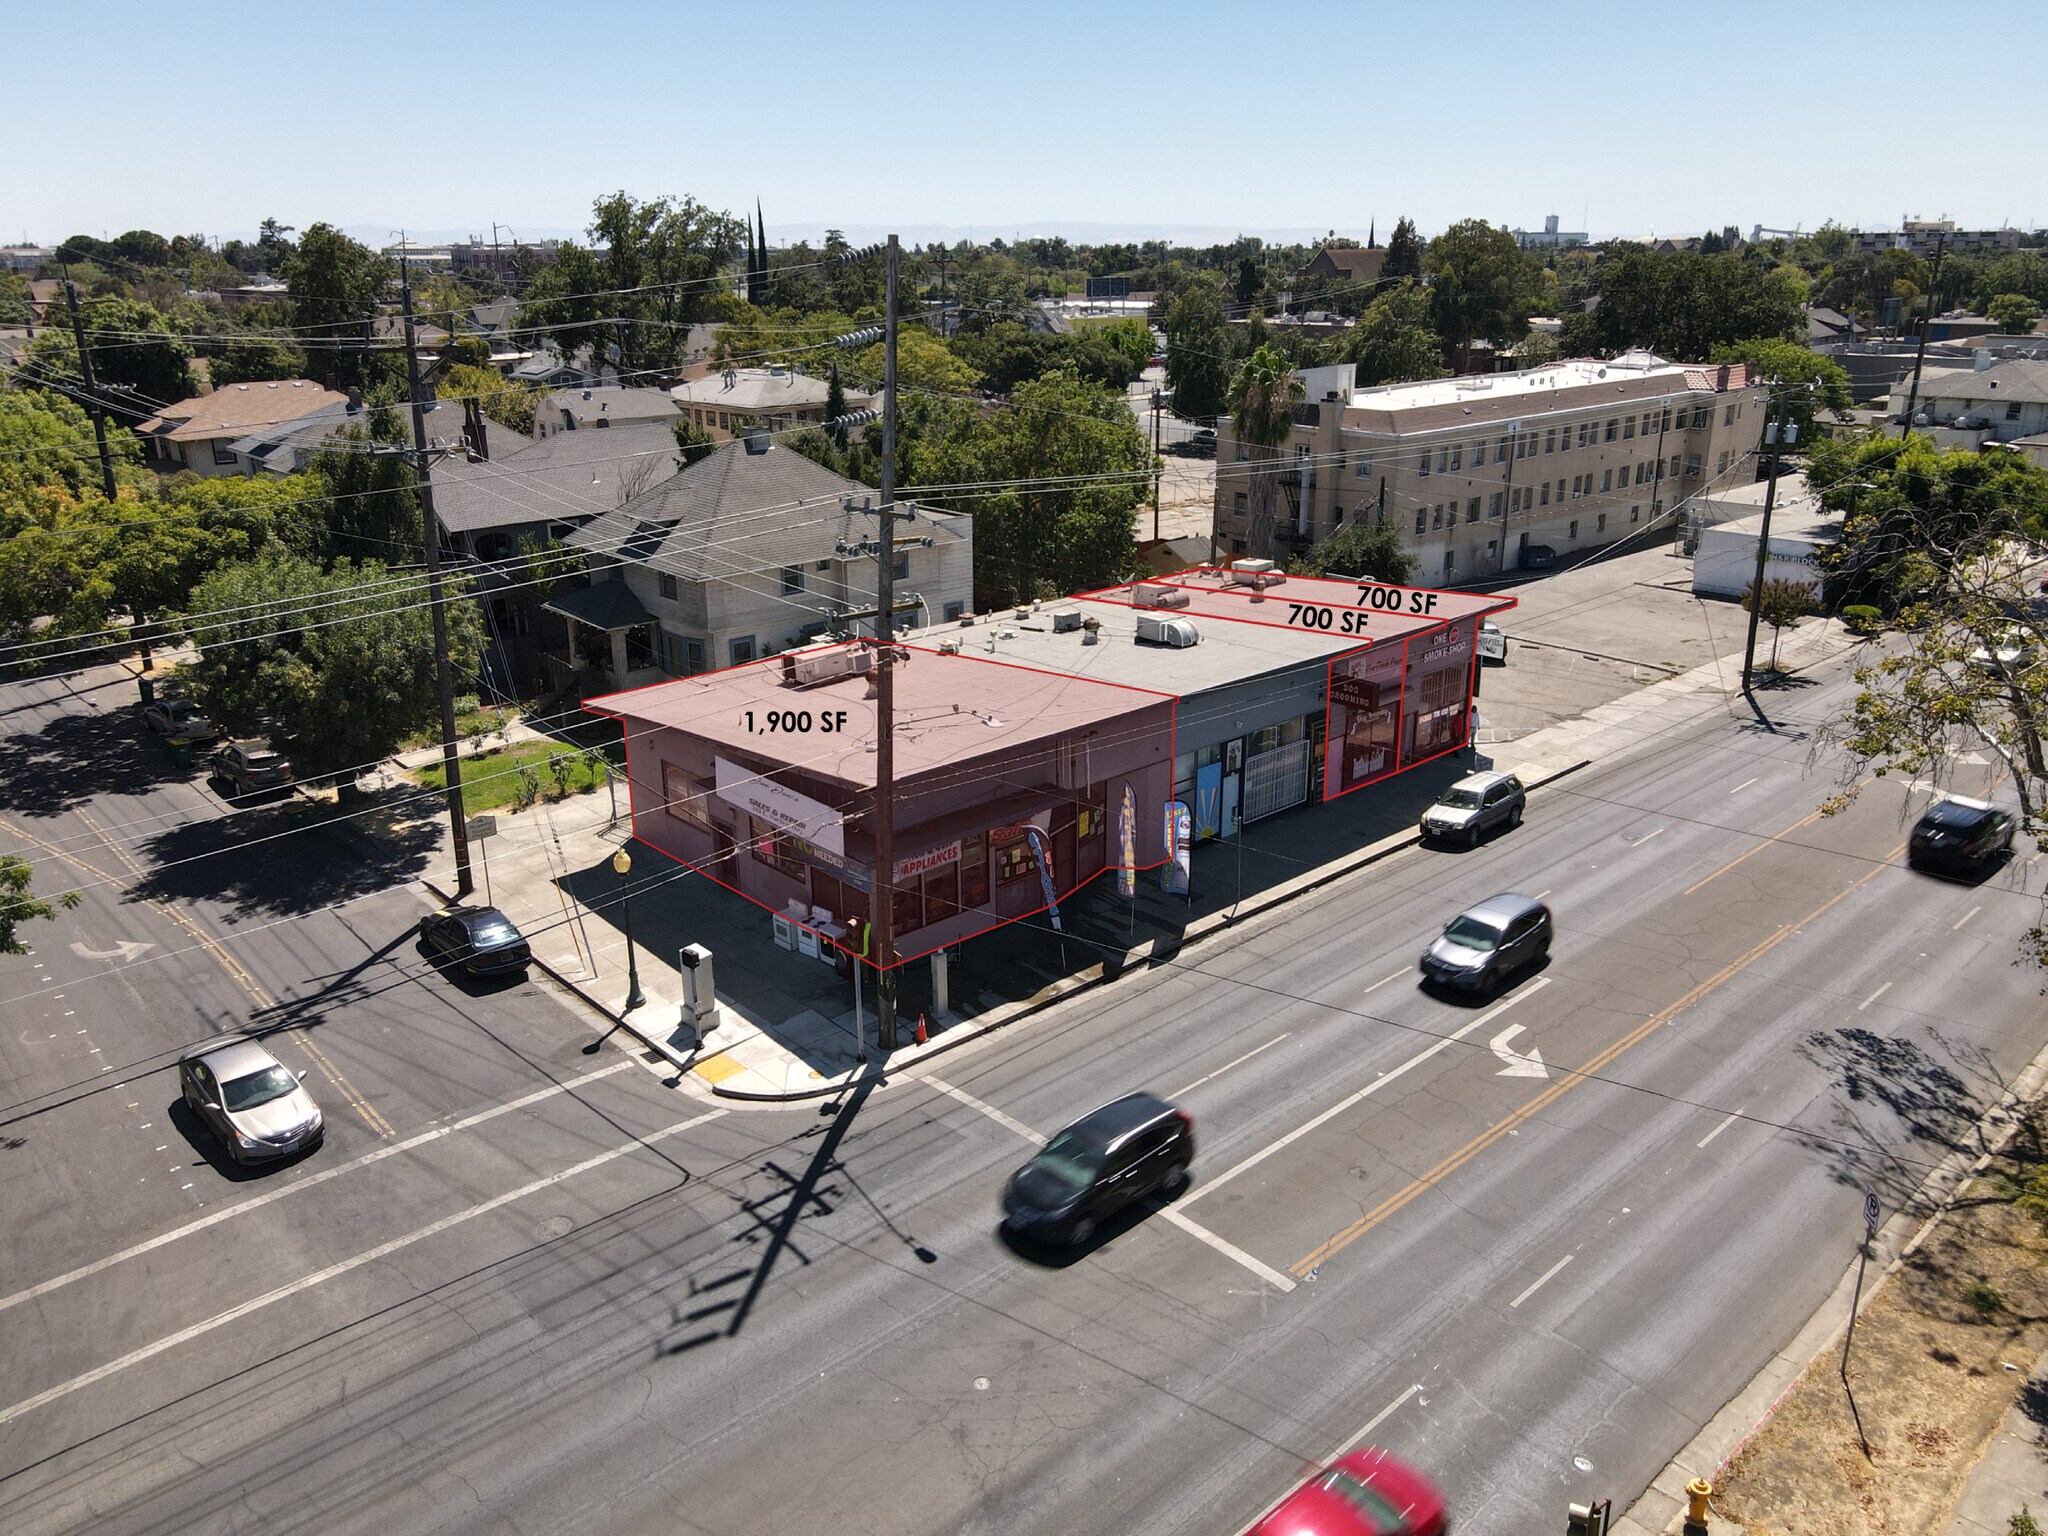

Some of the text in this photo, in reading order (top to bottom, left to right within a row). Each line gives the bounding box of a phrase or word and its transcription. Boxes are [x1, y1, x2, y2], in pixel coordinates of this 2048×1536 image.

[1772, 554, 1820, 566] H&R BLOCK
[1433, 633, 1448, 645] ONE
[1423, 646, 1448, 664] SMOKE
[1449, 641, 1466, 656] SHOP
[1343, 684, 1359, 694] DOG
[1330, 691, 1370, 707] GROOMING
[748, 798, 807, 830] SALES & REPAIR
[813, 847, 844, 869] NEEDED
[902, 846, 958, 876] APPLIANCES
